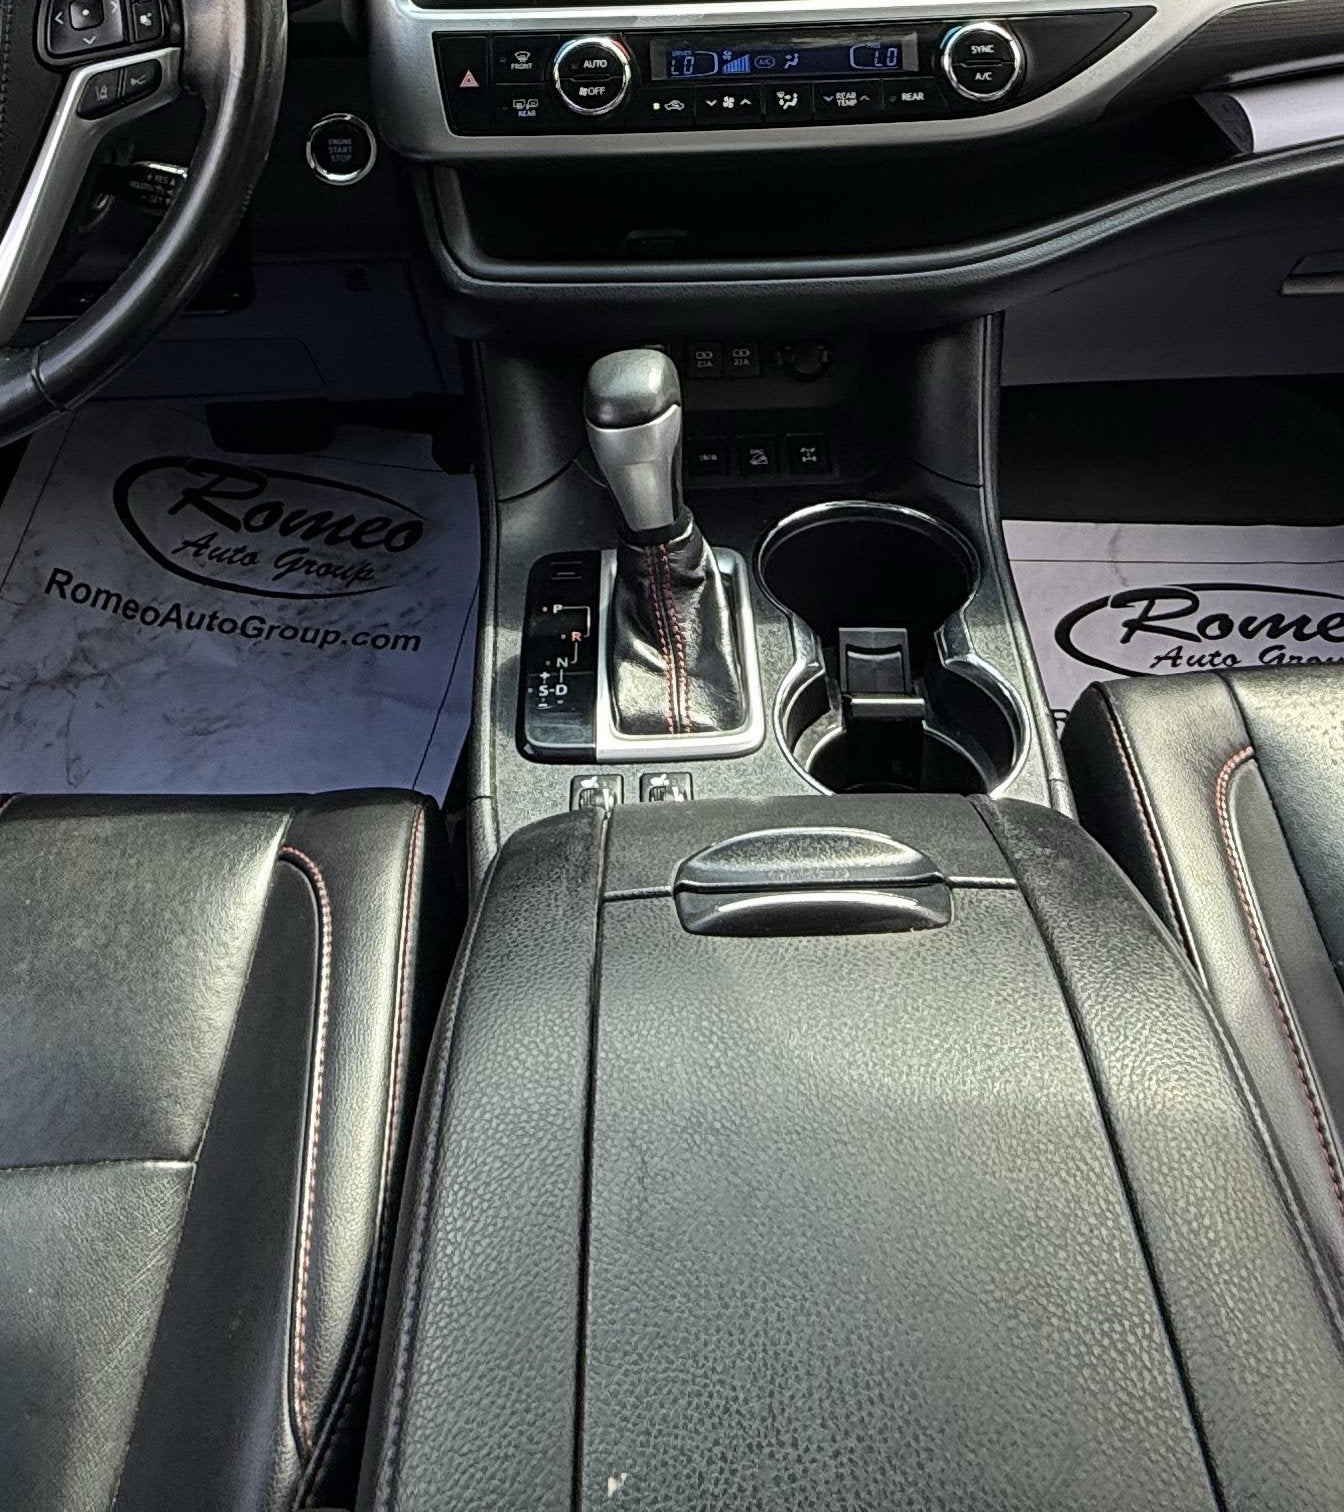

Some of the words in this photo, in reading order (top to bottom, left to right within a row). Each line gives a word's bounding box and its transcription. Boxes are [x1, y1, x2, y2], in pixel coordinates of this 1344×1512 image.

[971, 44, 994, 54] SYNC
[511, 62, 533, 70] FRONT
[583, 59, 608, 68] AUTO
[975, 72, 992, 81] A/C
[587, 87, 606, 96] OFF
[836, 91, 857, 99] REAR
[901, 92, 925, 102] REAR
[836, 99, 858, 108] TEMP
[328, 146, 352, 154] START
[330, 154, 352, 162] STOP
[168, 458, 427, 554] Romeo
[173, 532, 260, 568] Auto
[270, 546, 376, 587] Group
[44, 567, 423, 653] RomeoAutoGroup.com
[552, 604, 563, 614] P
[572, 631, 582, 642] R
[1149, 645, 1241, 669] Auto
[556, 657, 569, 668] N
[538, 684, 549, 697] S
[555, 684, 568, 697] D
